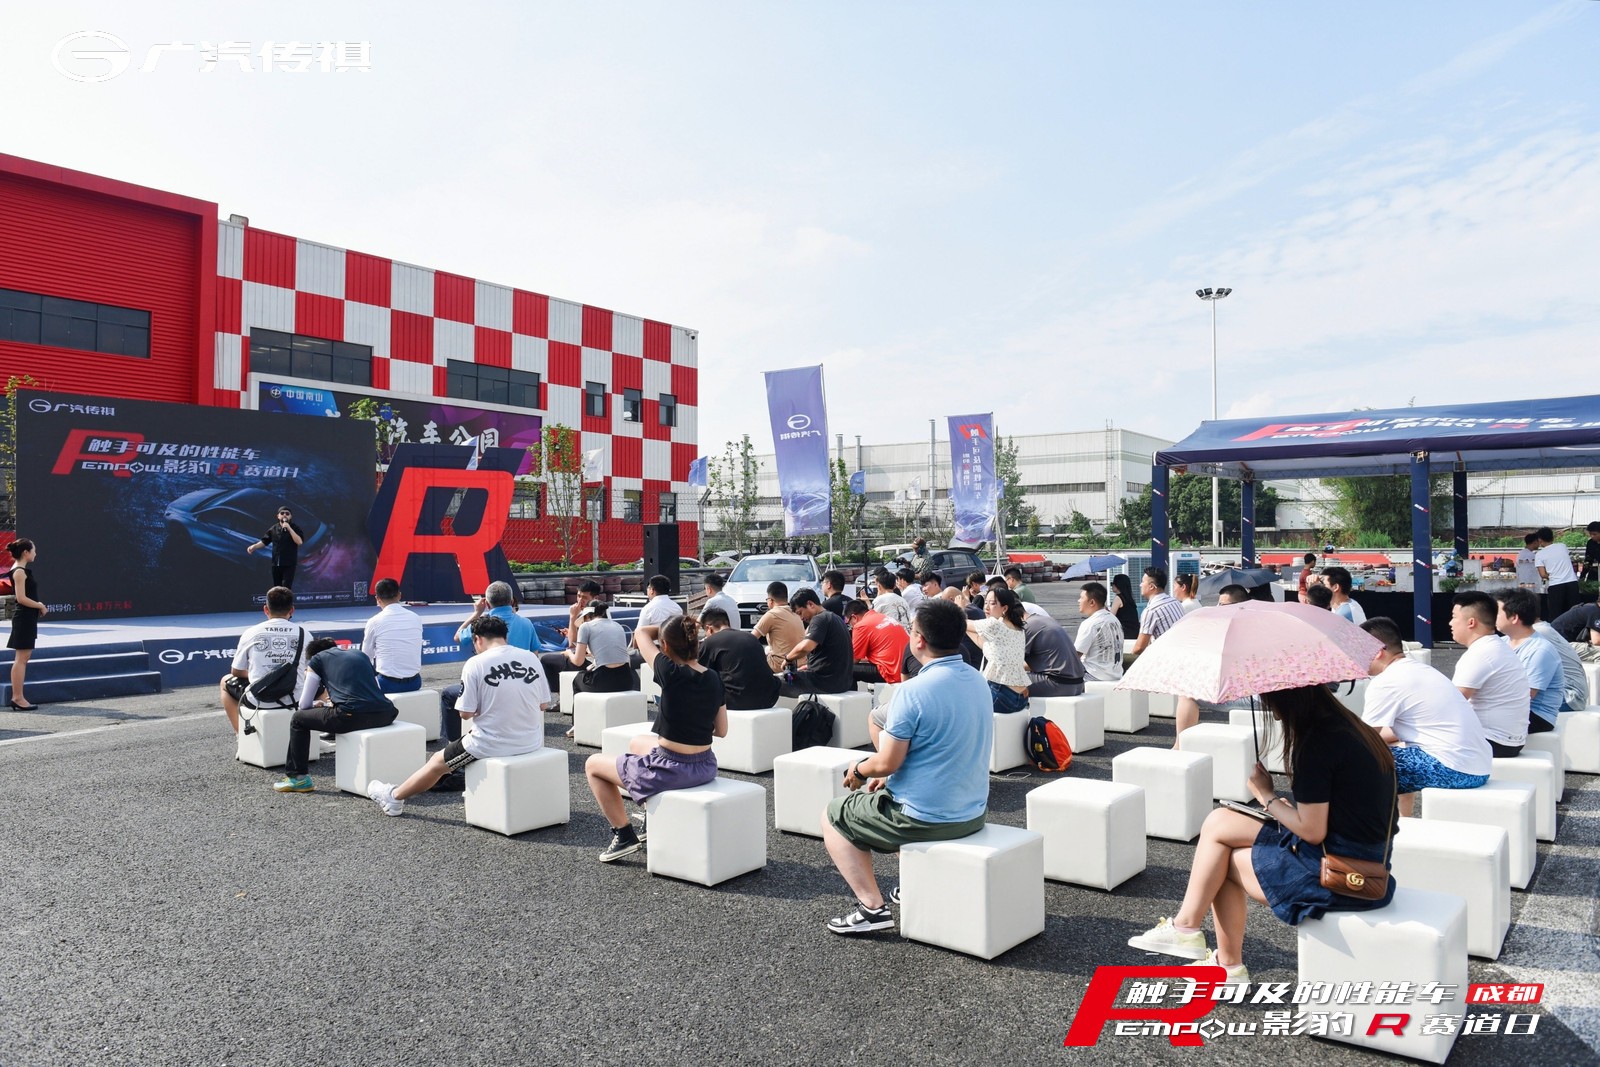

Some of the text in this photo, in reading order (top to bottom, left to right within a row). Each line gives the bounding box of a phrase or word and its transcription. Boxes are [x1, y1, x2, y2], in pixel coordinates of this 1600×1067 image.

[286, 389, 323, 402] 中国南山
[53, 403, 115, 416] 广汽传祺
[371, 416, 499, 453] 汽车公园
[87, 438, 261, 461] 触手可及的性能车
[368, 467, 515, 596] R
[186, 648, 238, 661] 广汽传
